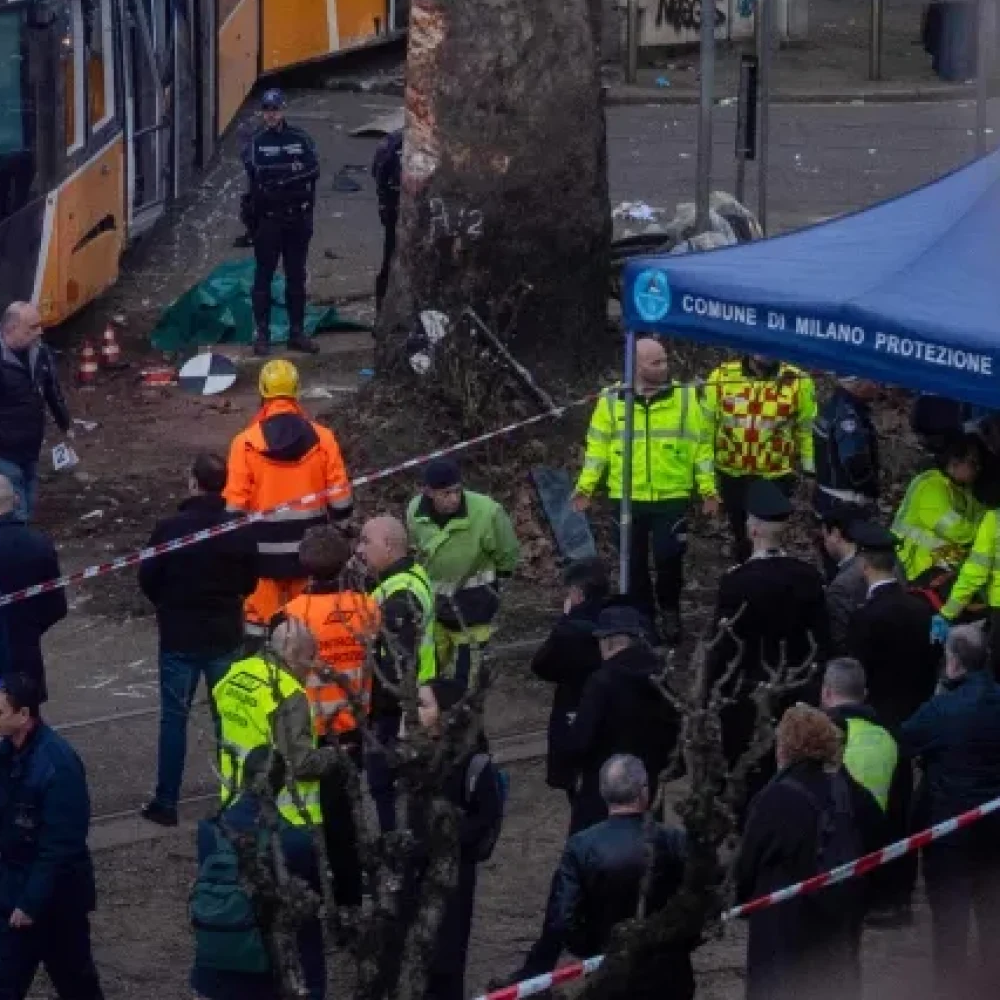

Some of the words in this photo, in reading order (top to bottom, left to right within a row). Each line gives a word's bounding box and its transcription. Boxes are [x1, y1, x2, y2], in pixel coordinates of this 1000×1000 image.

[682, 294, 757, 326] COMUNE
[767, 311, 785, 330] DI
[795, 315, 865, 346] MILANO
[875, 332, 992, 375] PROTEZIONE
